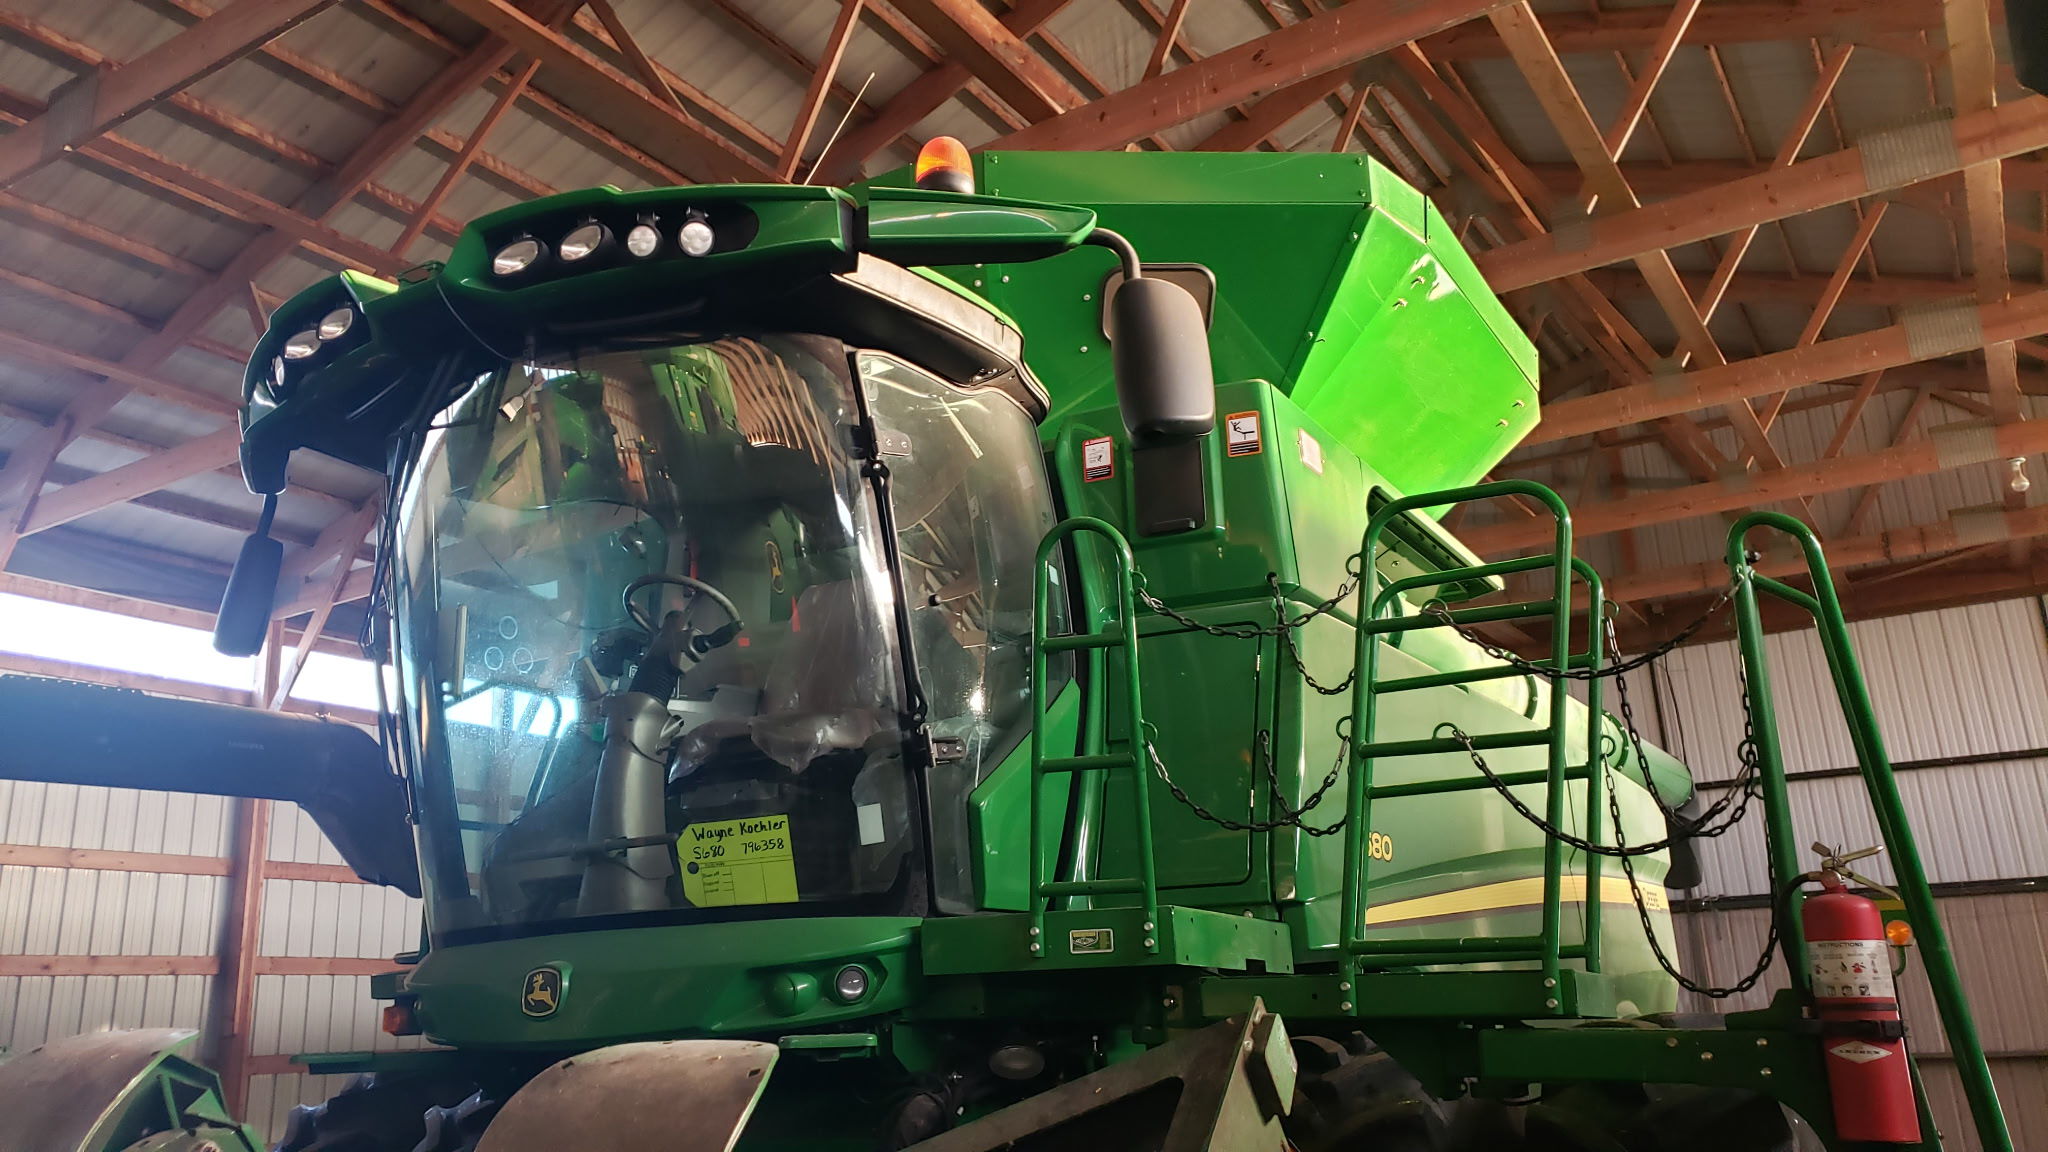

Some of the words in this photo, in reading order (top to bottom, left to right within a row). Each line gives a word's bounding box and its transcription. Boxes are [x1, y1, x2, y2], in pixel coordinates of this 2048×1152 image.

[692, 825, 735, 843] Wayne
[739, 820, 786, 836] Koehler
[693, 844, 725, 860] S680
[740, 837, 785, 855] 796358
